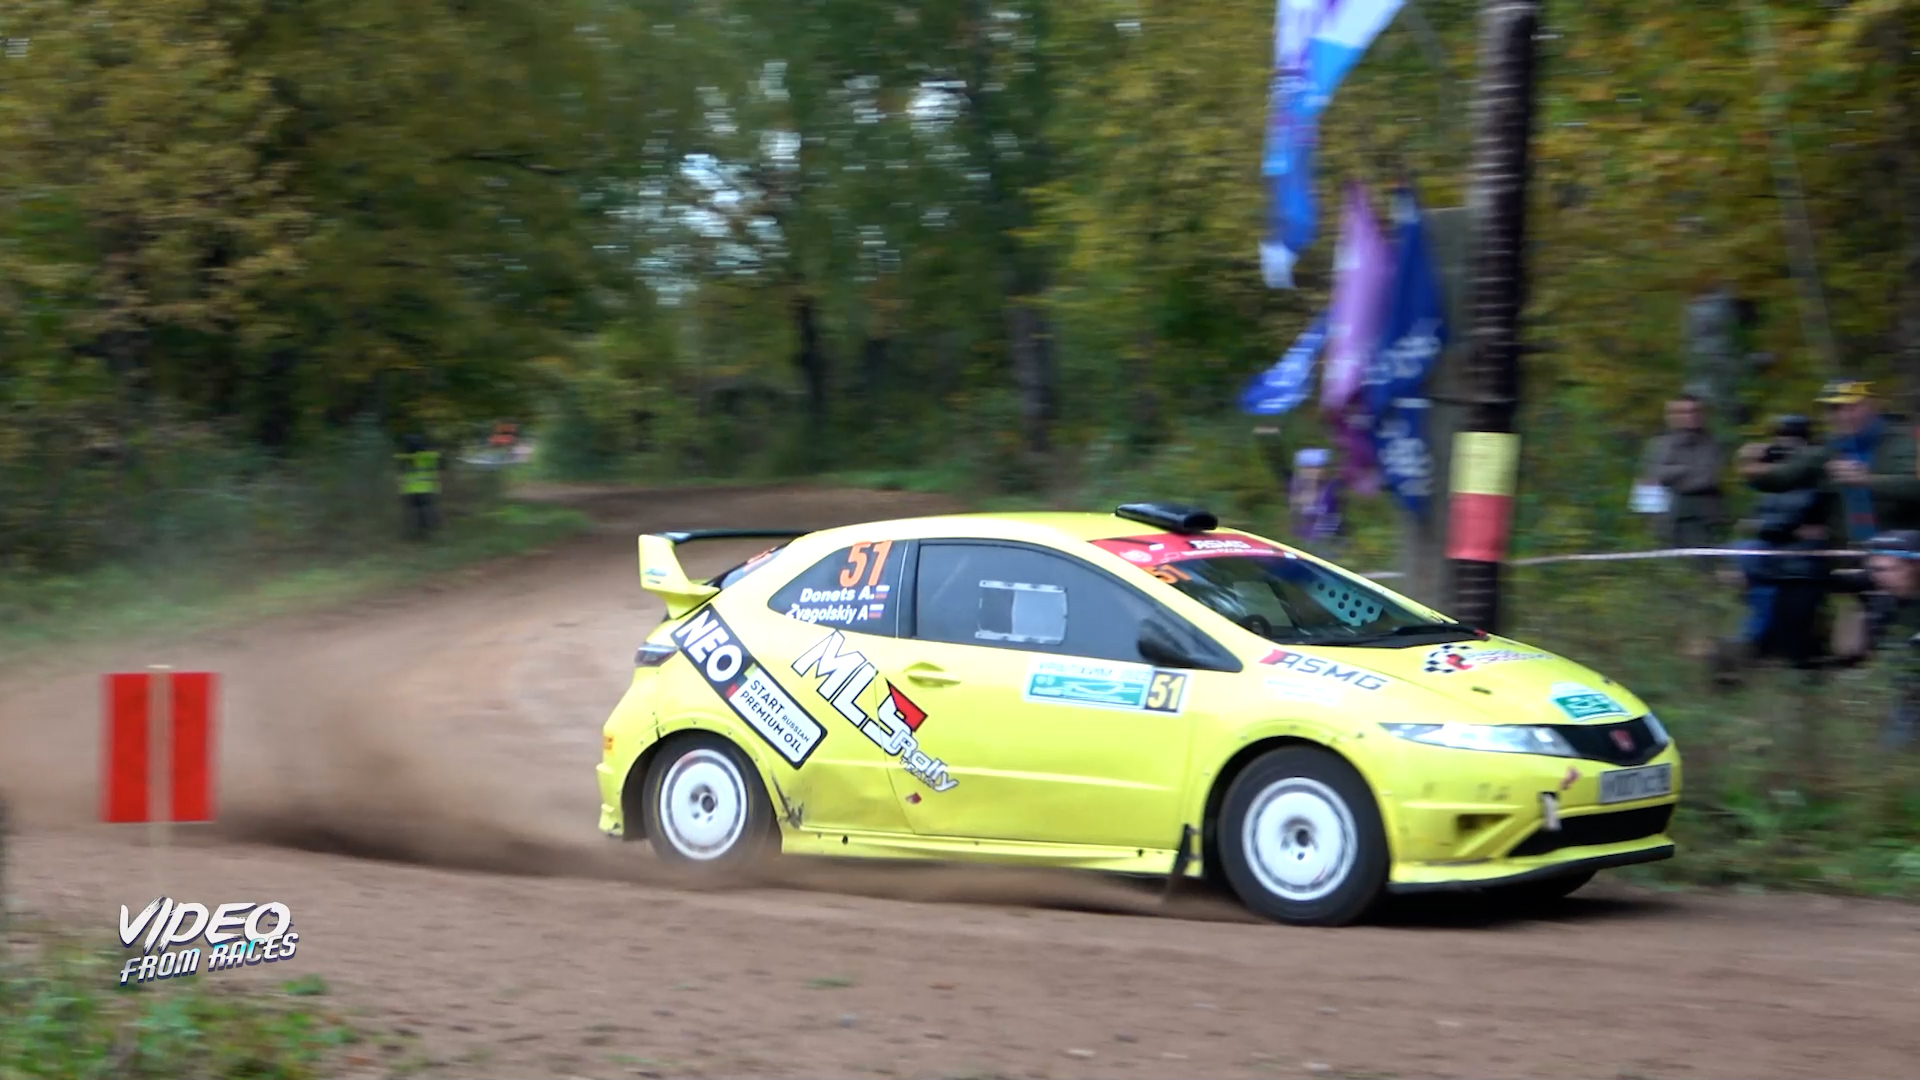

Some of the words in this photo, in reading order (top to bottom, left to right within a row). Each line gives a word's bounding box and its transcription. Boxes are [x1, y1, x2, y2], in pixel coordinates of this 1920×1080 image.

[839, 539, 893, 588] 51
[800, 587, 856, 603] Donets
[857, 585, 875, 601] A.
[857, 604, 869, 621] A
[675, 610, 743, 683] NEO
[1260, 649, 1389, 691] ASMG
[750, 679, 785, 714] START
[781, 714, 810, 743] RUSSIAN
[791, 629, 928, 757] MLS
[1147, 673, 1185, 710] 51
[740, 690, 785, 736] PREMIUM
[783, 733, 802, 754] OIL
